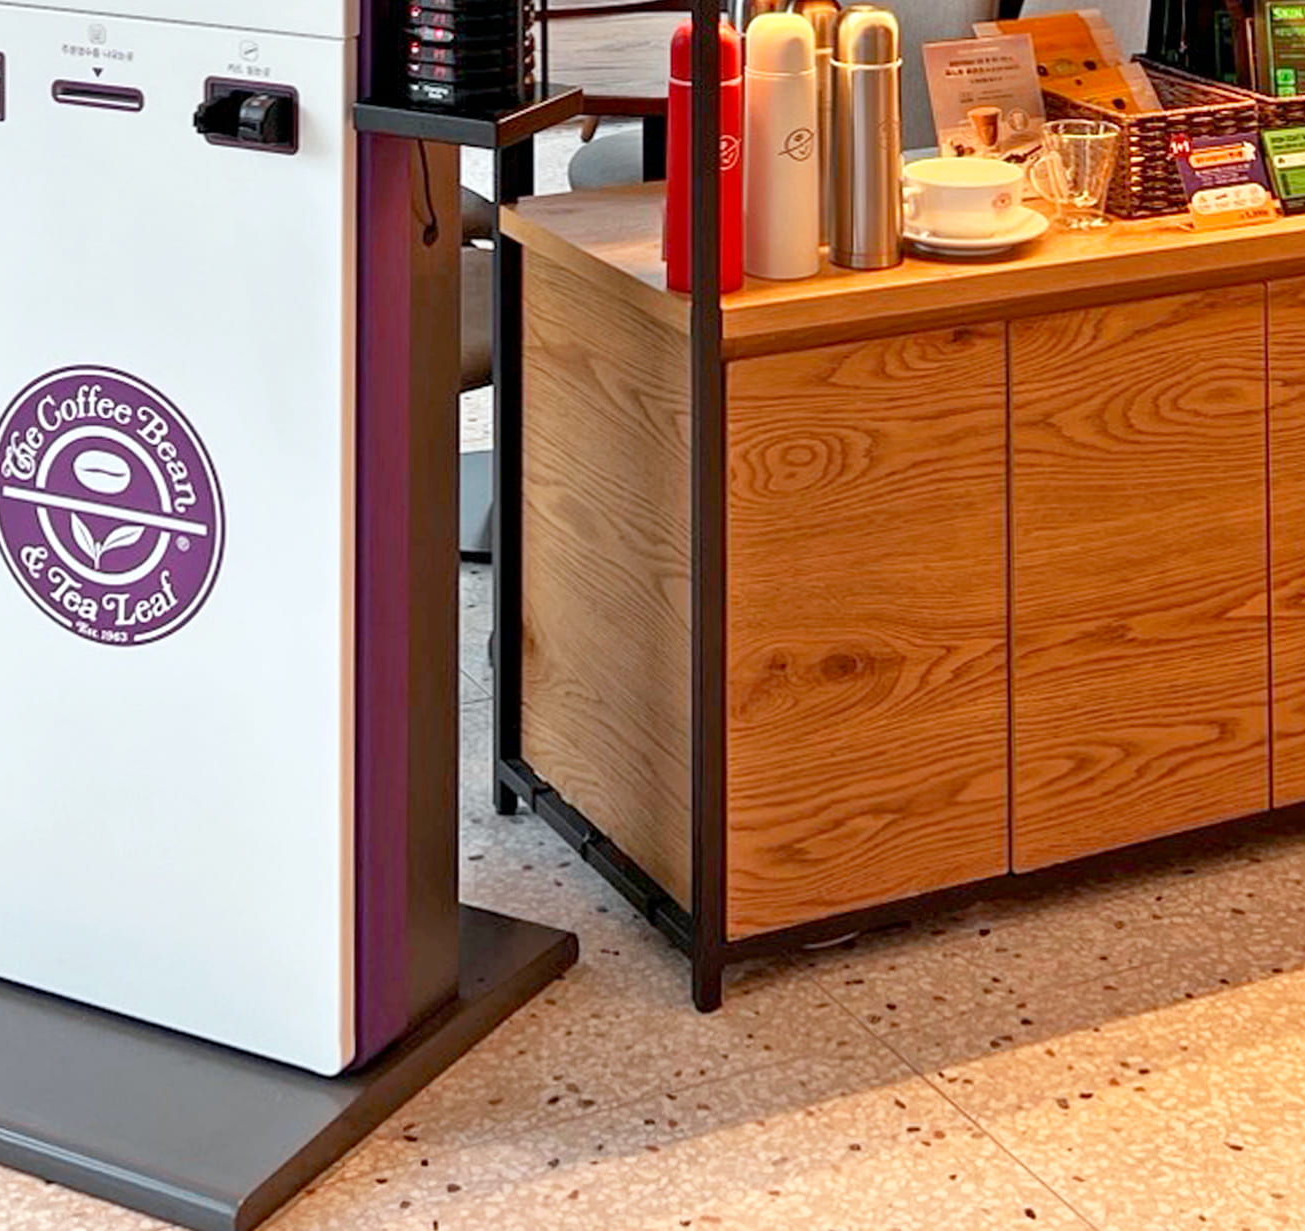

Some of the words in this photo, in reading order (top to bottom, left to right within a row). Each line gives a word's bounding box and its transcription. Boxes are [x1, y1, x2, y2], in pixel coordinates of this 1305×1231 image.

[0, 431, 45, 481] The
[37, 384, 133, 432] Coffee
[135, 405, 197, 514] Bean
[20, 545, 48, 579] &
[47, 566, 99, 621] Tea
[102, 569, 178, 626] Leaf
